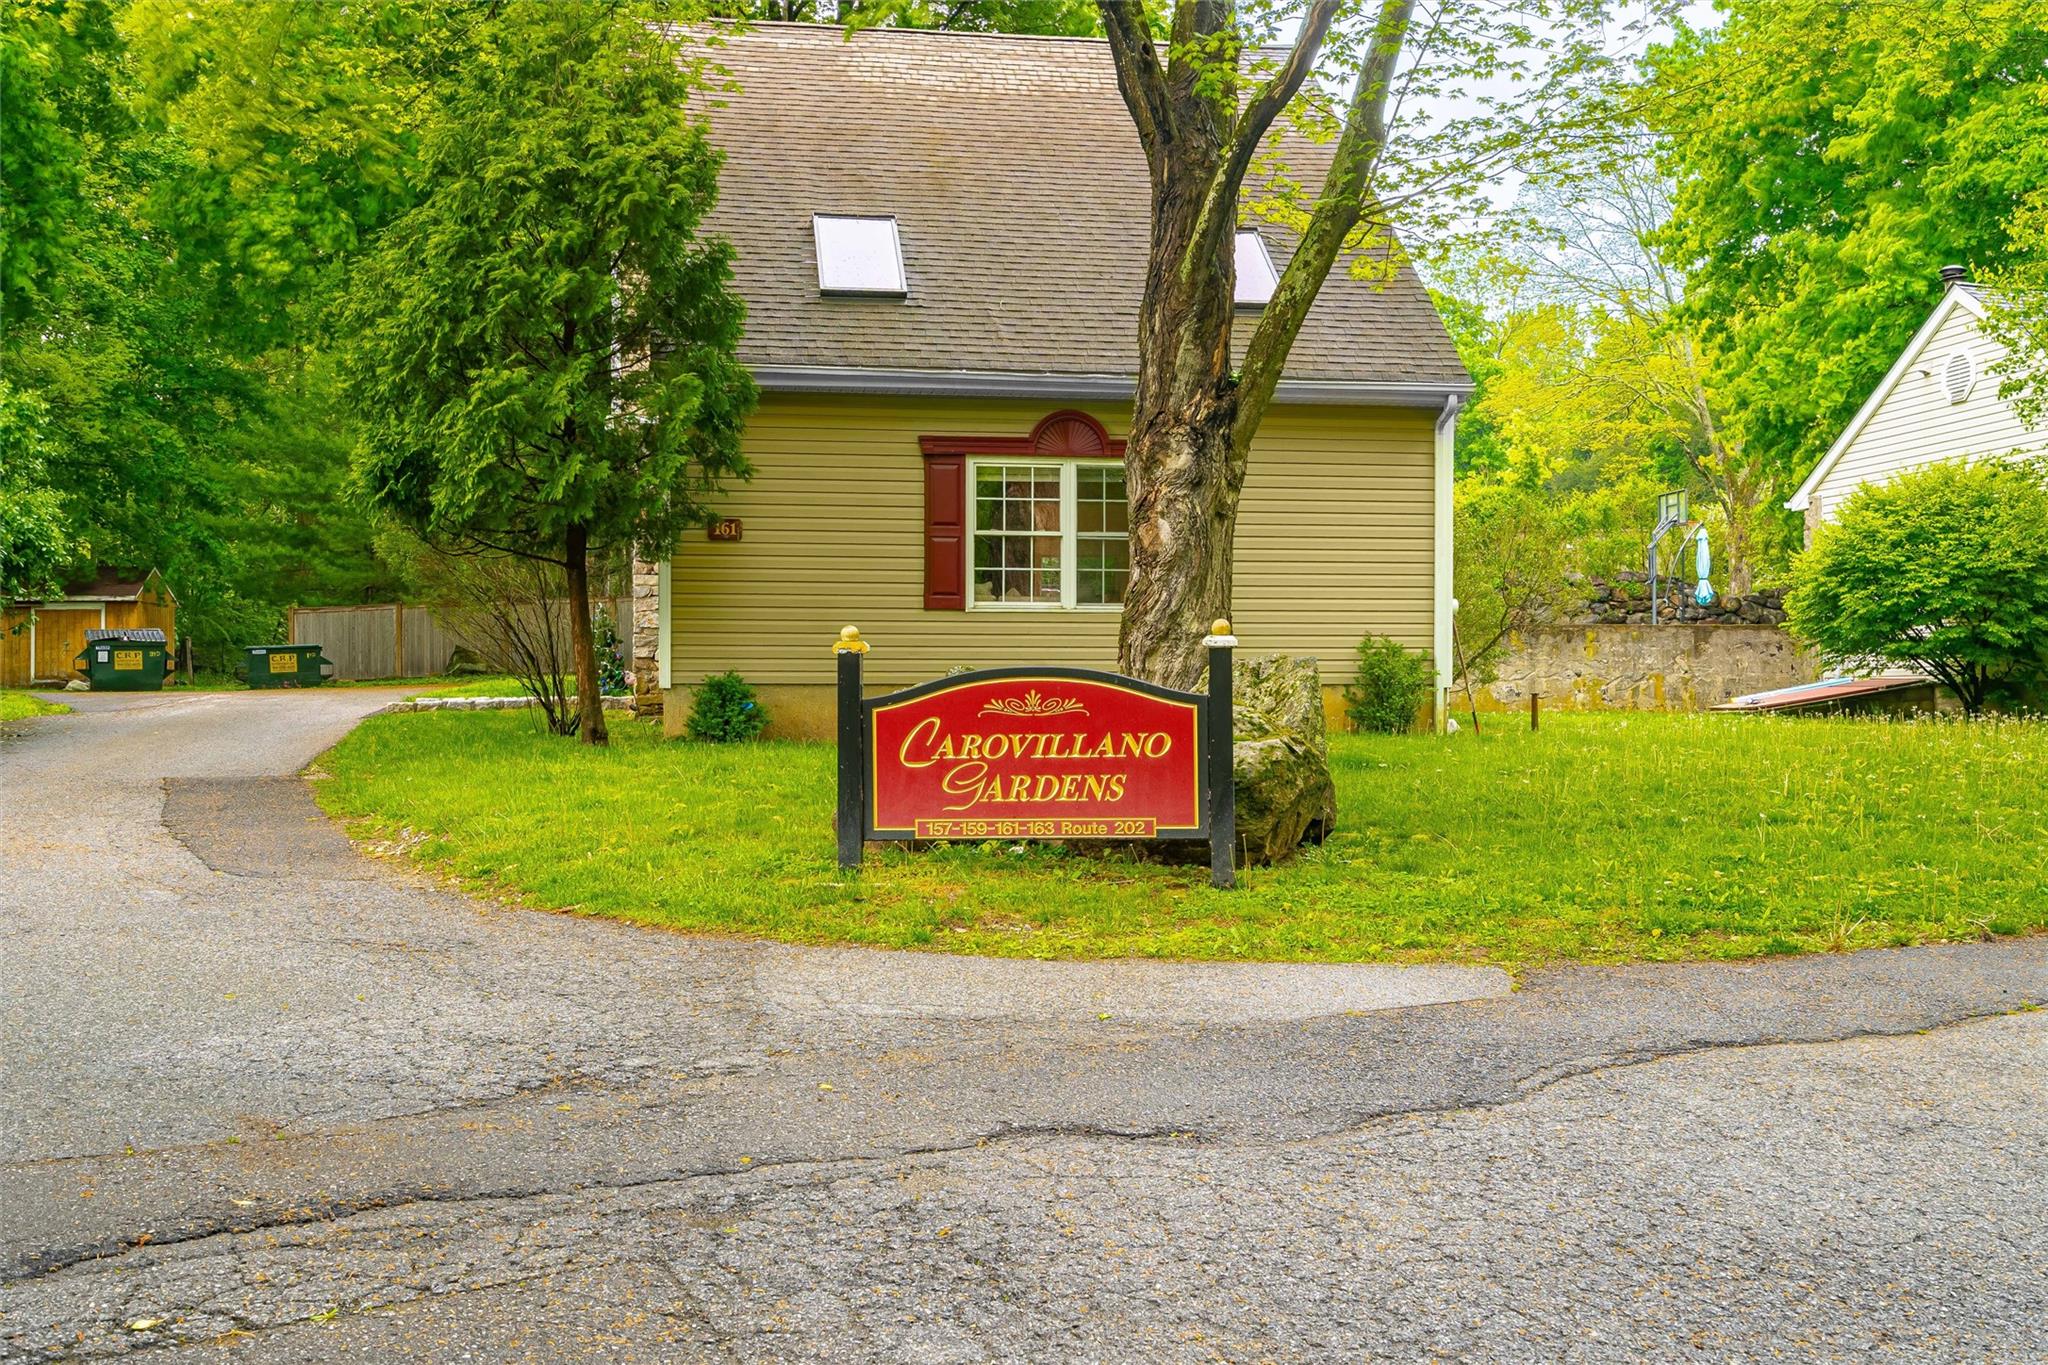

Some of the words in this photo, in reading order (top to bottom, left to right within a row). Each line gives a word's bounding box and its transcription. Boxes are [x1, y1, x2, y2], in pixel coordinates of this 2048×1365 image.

[713, 522, 737, 536] 161
[899, 717, 1172, 767] CAROVILLANO
[941, 761, 1127, 811] GARDENS
[925, 821, 1055, 836] 157-159-161-163
[1061, 821, 1108, 836] Route
[1114, 821, 1145, 836] 202
